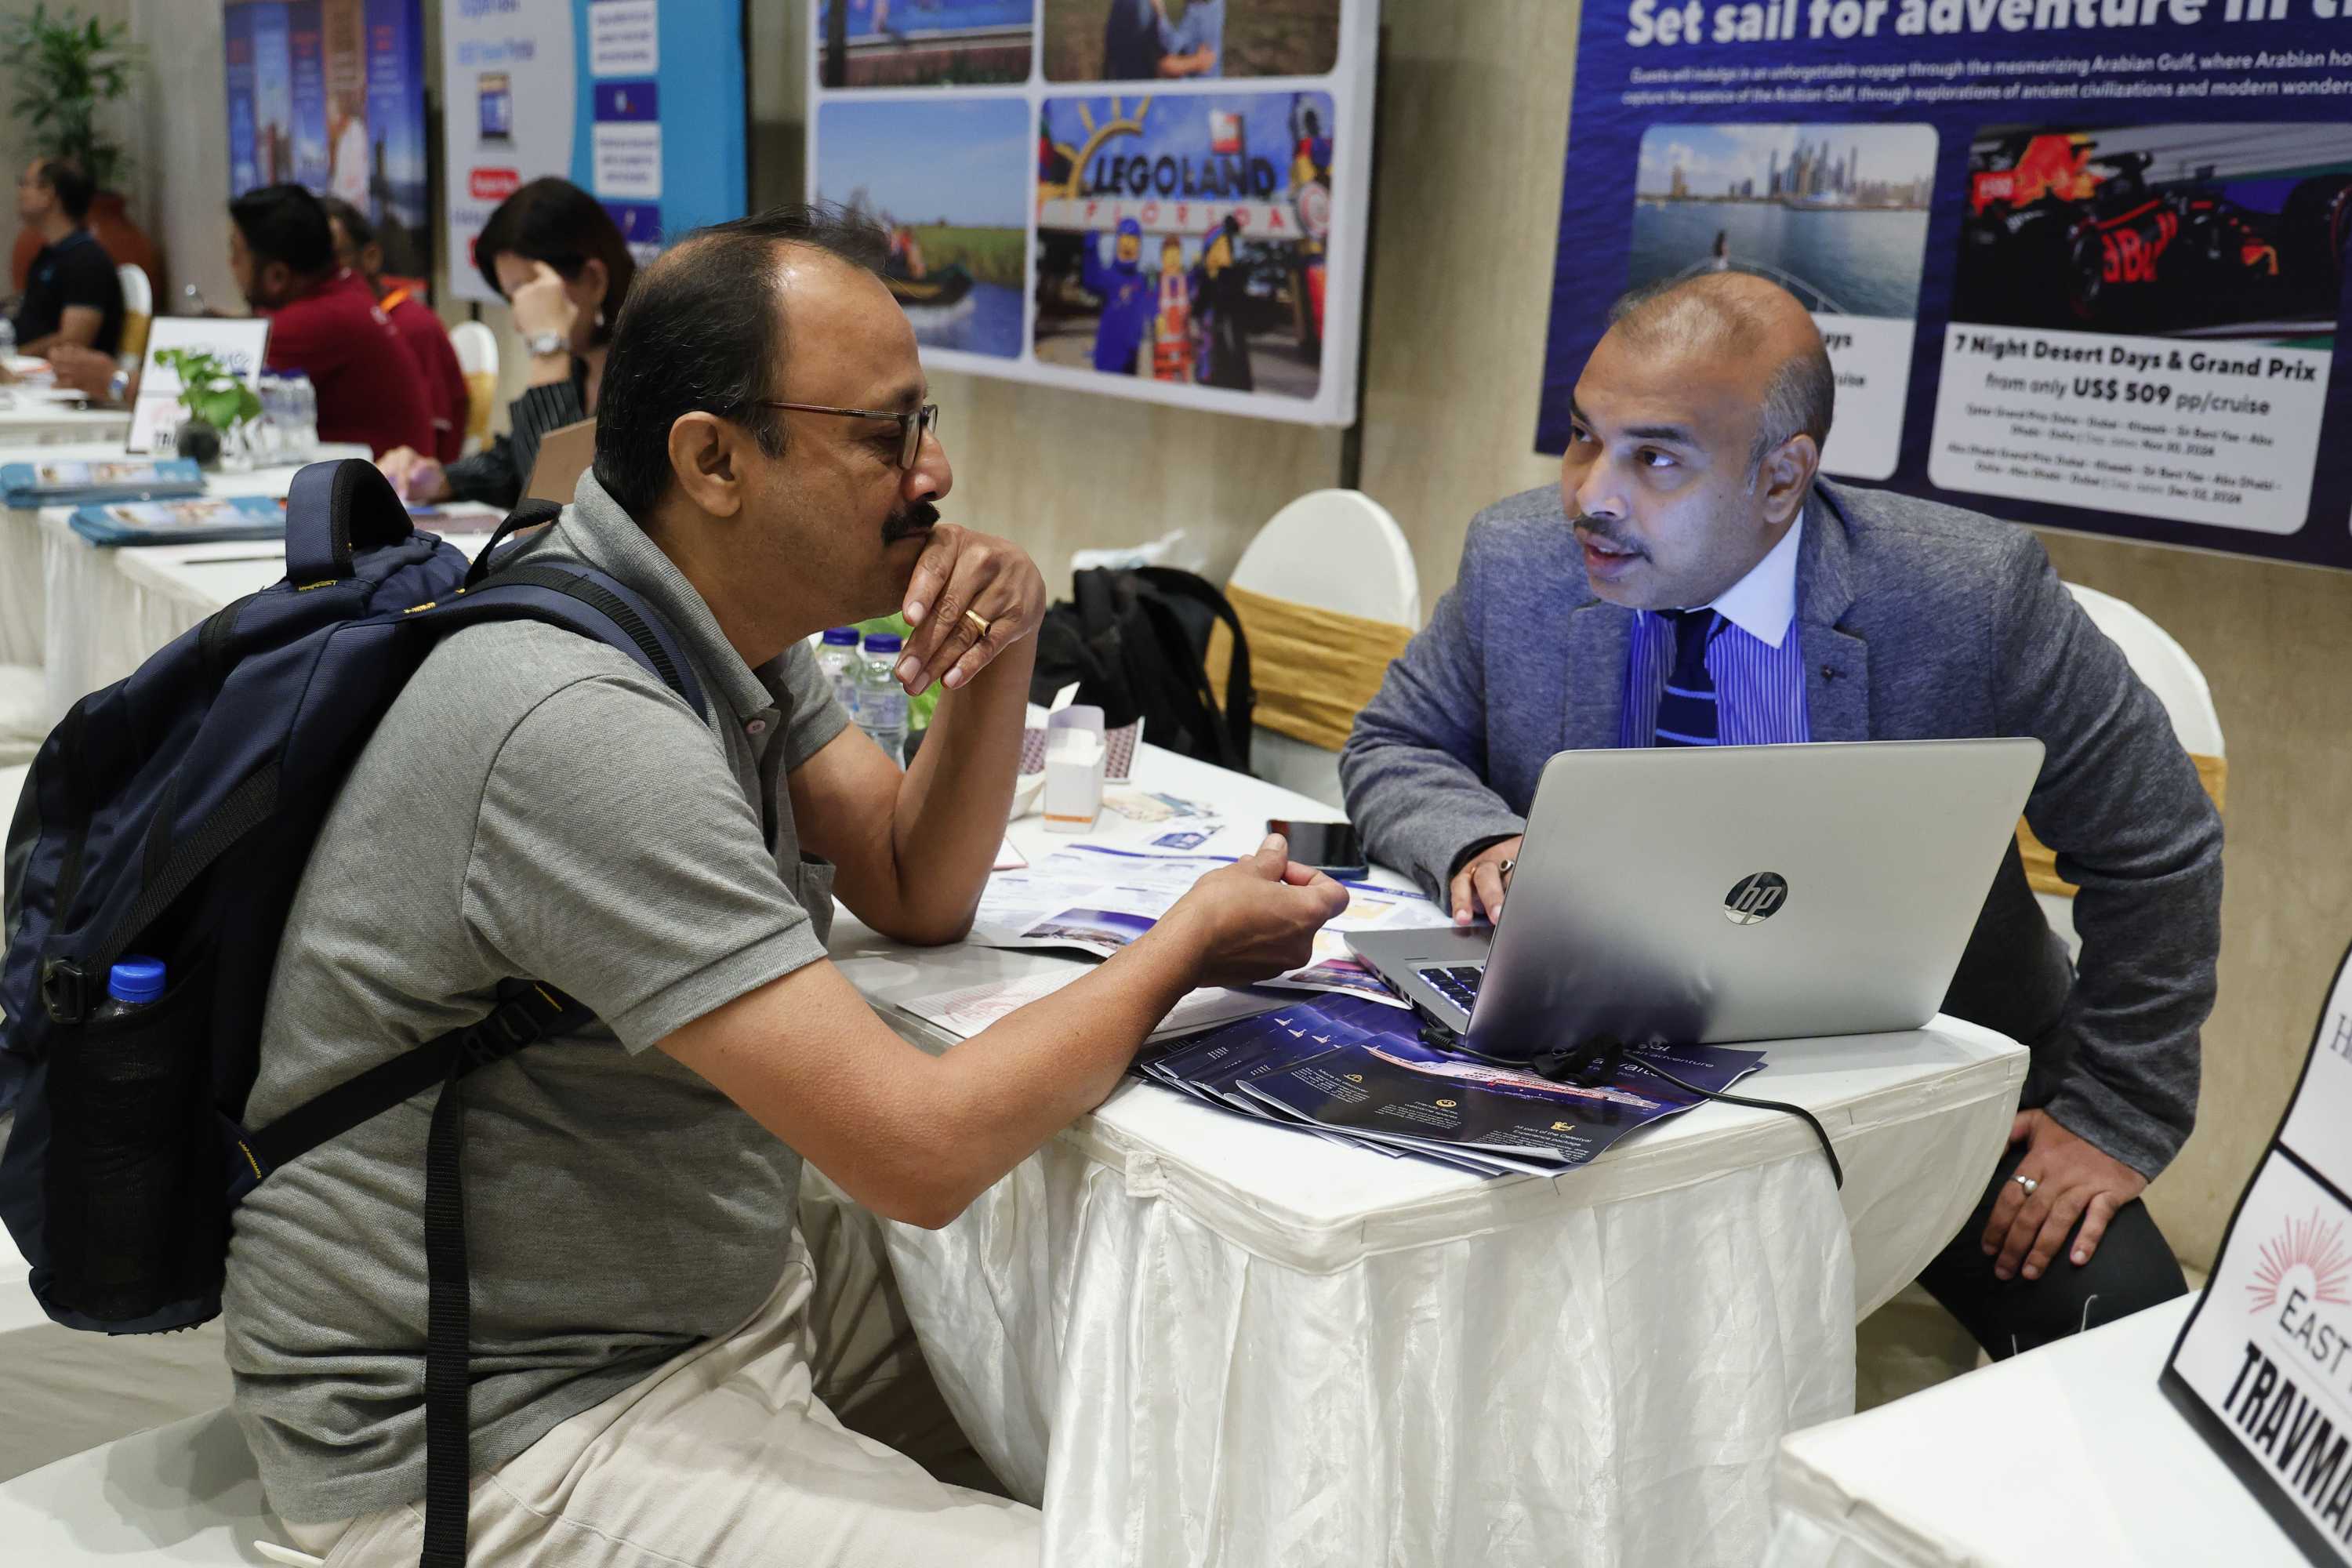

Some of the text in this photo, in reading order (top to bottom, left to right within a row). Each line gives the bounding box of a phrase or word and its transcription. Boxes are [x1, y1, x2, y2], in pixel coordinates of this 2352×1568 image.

[1626, 0, 1704, 47] Set
[1712, 0, 1798, 43] sail
[1809, 0, 1887, 39] for
[1895, 0, 2206, 36] adventure
[1908, 59, 1965, 80] through
[1966, 58, 1992, 75] the
[2090, 54, 2155, 73] Arabian
[2157, 52, 2197, 73] Gulf,
[2199, 52, 2253, 70] where
[2254, 49, 2325, 69] Arabian
[2328, 48, 2352, 67] ho
[2175, 78, 2209, 96] and
[2209, 77, 2278, 96] modern
[1094, 156, 1276, 198] LEGOLAND
[1085, 201, 1286, 230] FLORIDA
[1955, 335, 2317, 382] 7 Night Desert Days & Grand Prix
[1985, 371, 2272, 416] from only US$ 509 pp/cruise
[1730, 871, 1783, 925] hp
[2279, 1286, 2351, 1375] EAST
[2223, 1338, 2352, 1544] TRAVMA
